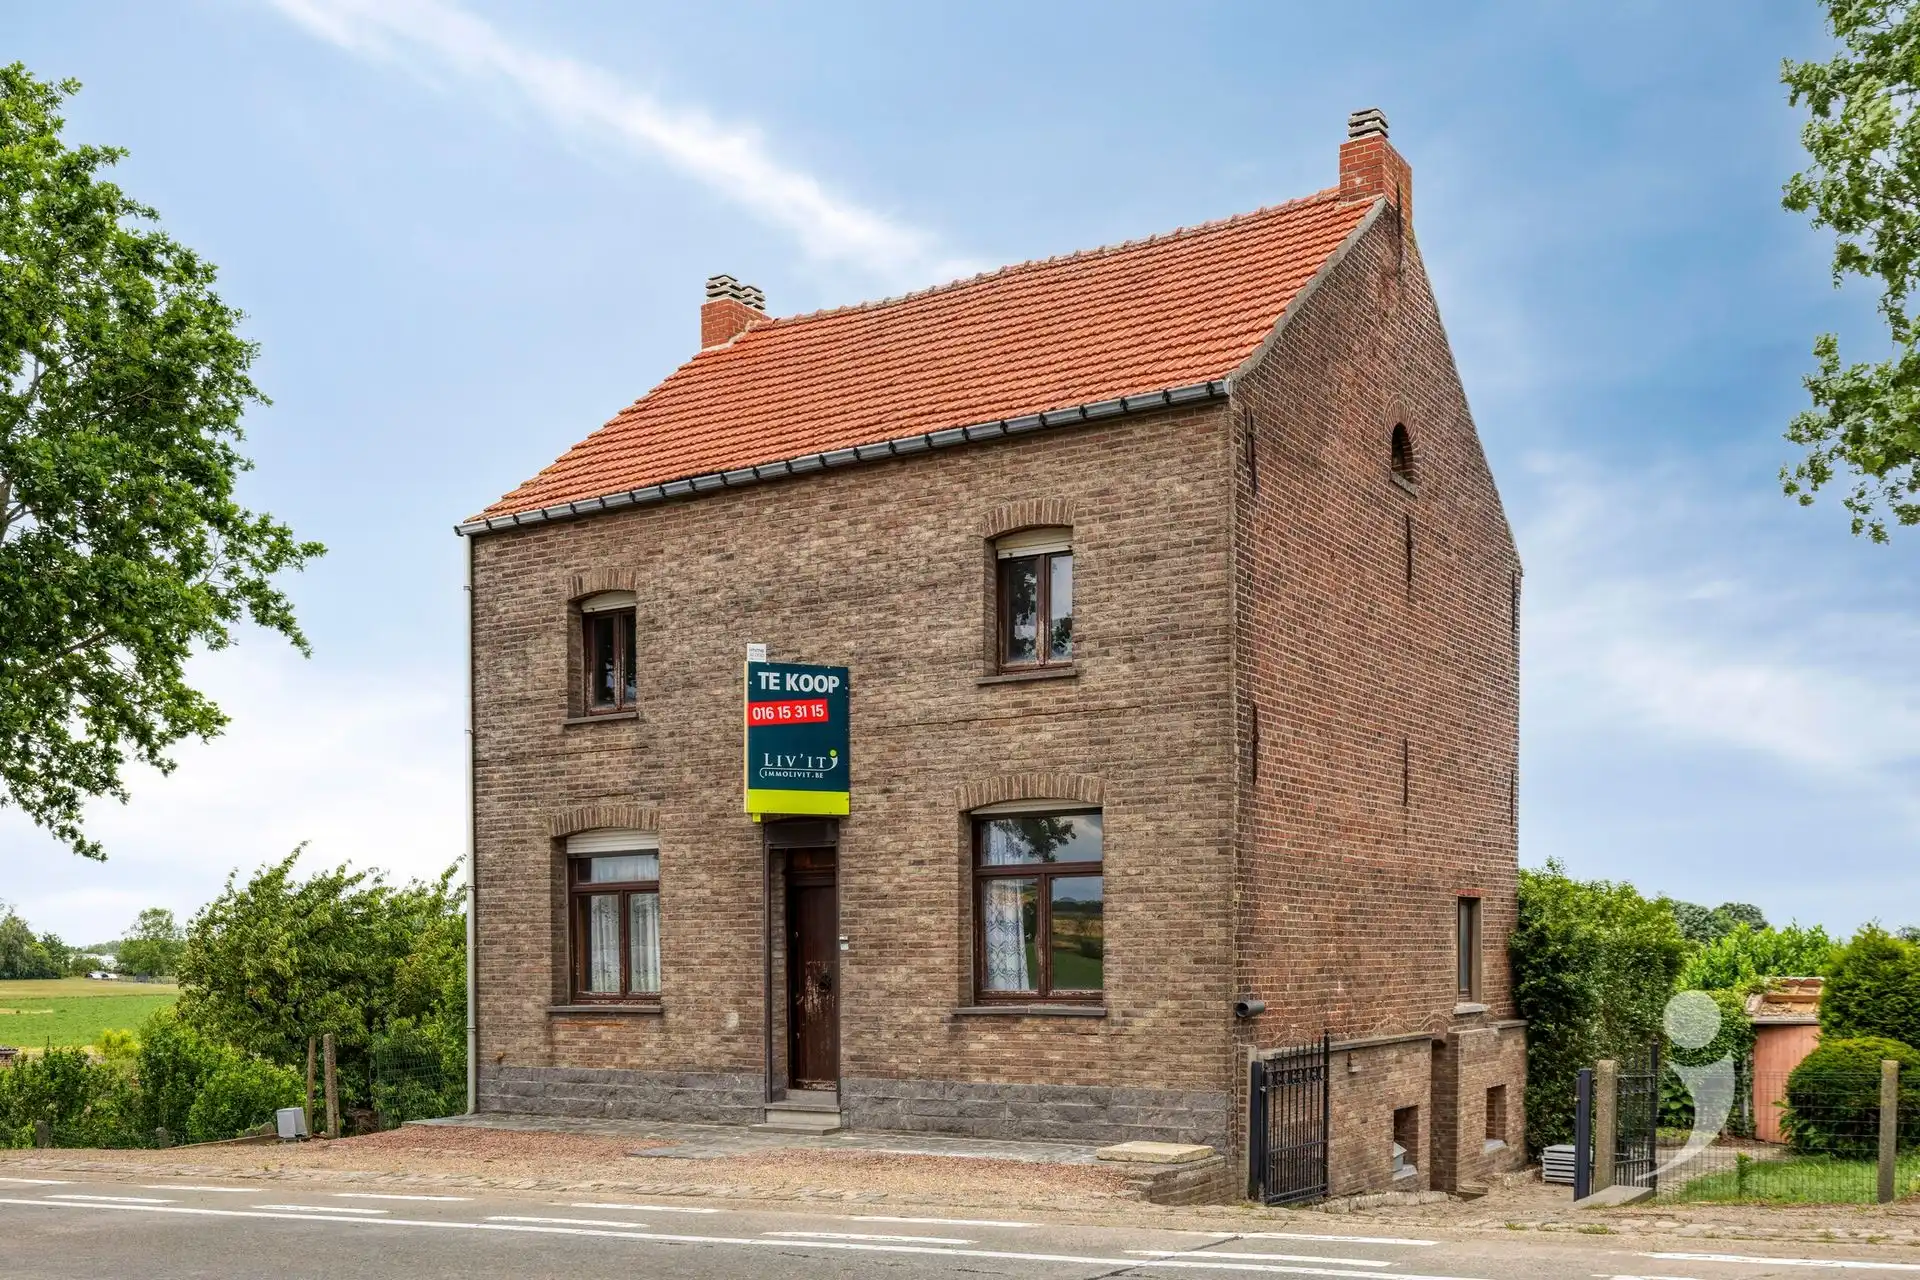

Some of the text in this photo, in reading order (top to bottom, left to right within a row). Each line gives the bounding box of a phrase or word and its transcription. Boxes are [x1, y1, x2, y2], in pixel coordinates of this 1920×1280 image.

[757, 671, 840, 693] TE KOOP
[752, 704, 824, 720] 016 15 31 15
[764, 770, 824, 779] IMMOLIVIT.BE
